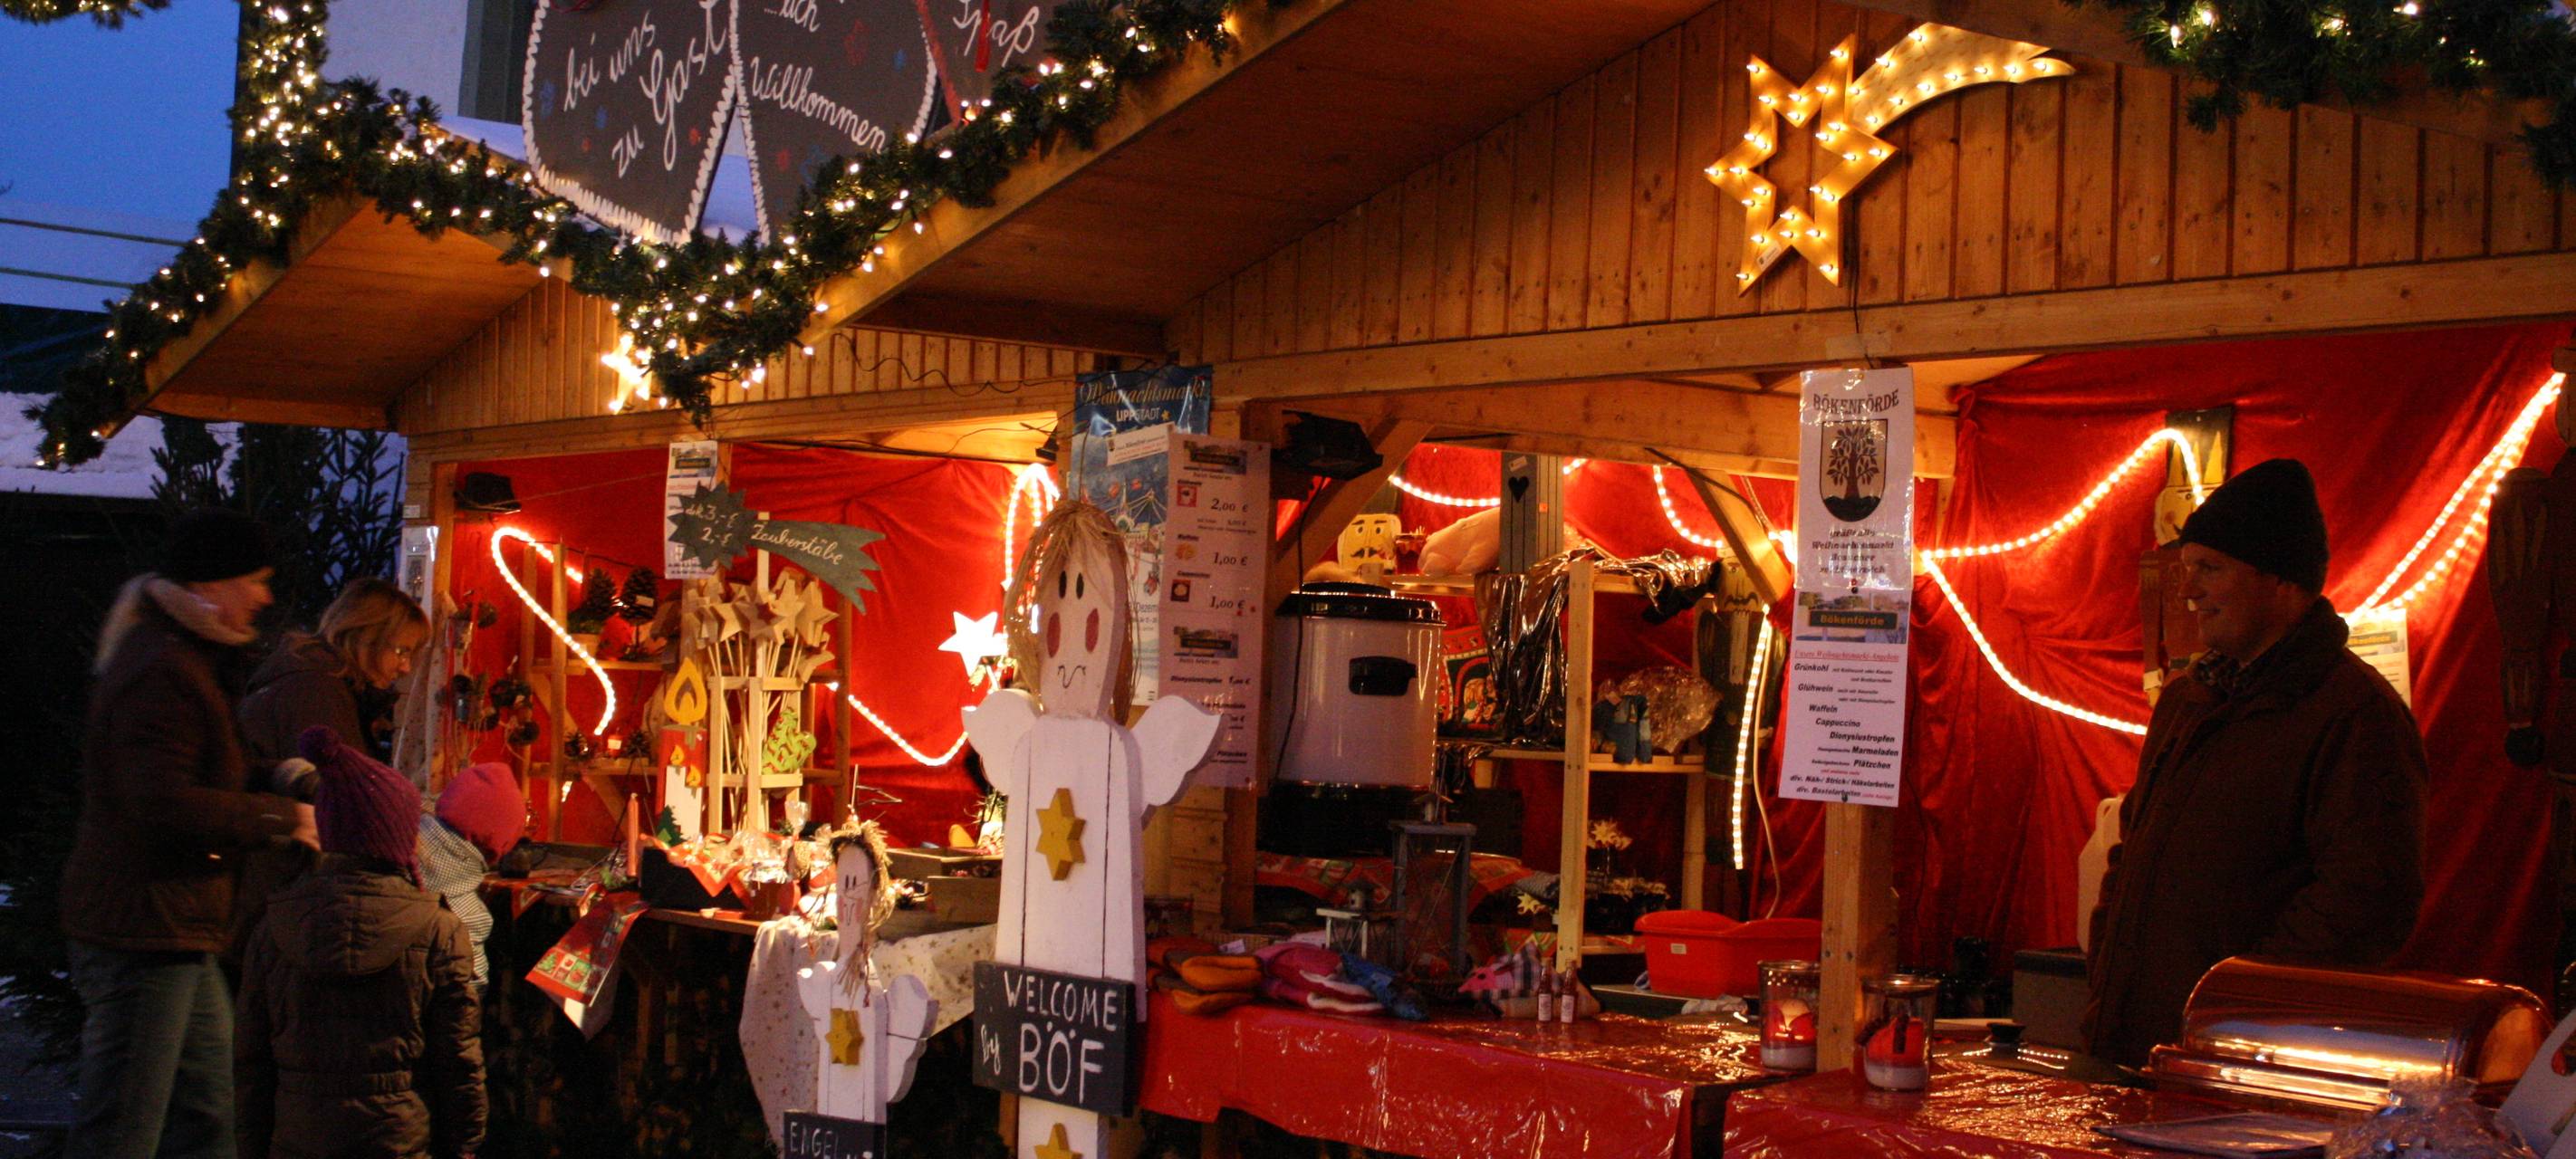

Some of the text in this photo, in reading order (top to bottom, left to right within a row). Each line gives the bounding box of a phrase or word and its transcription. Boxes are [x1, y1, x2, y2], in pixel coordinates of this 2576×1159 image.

[563, 9, 656, 112] bei uns
[611, 0, 726, 178] zu Gast
[750, 56, 886, 155] Willkommen
[1813, 388, 1899, 417] BÖKENFÖRDE
[1116, 407, 1161, 422] LIPPSTADT
[751, 524, 843, 566] Zauberstäbe
[1820, 614, 1884, 627] Bökenförde
[1794, 663, 1830, 672] Grünkohl
[1798, 683, 1833, 692] Glühwein
[1809, 704, 1838, 713] Waffeln
[1815, 718, 1860, 727] Cappuccino
[1851, 746, 1898, 756] Marmeladen
[1853, 760, 1891, 769] Plätzchen
[1004, 971, 1117, 1031] WELCOME
[981, 1021, 1104, 1104] by BÖF
